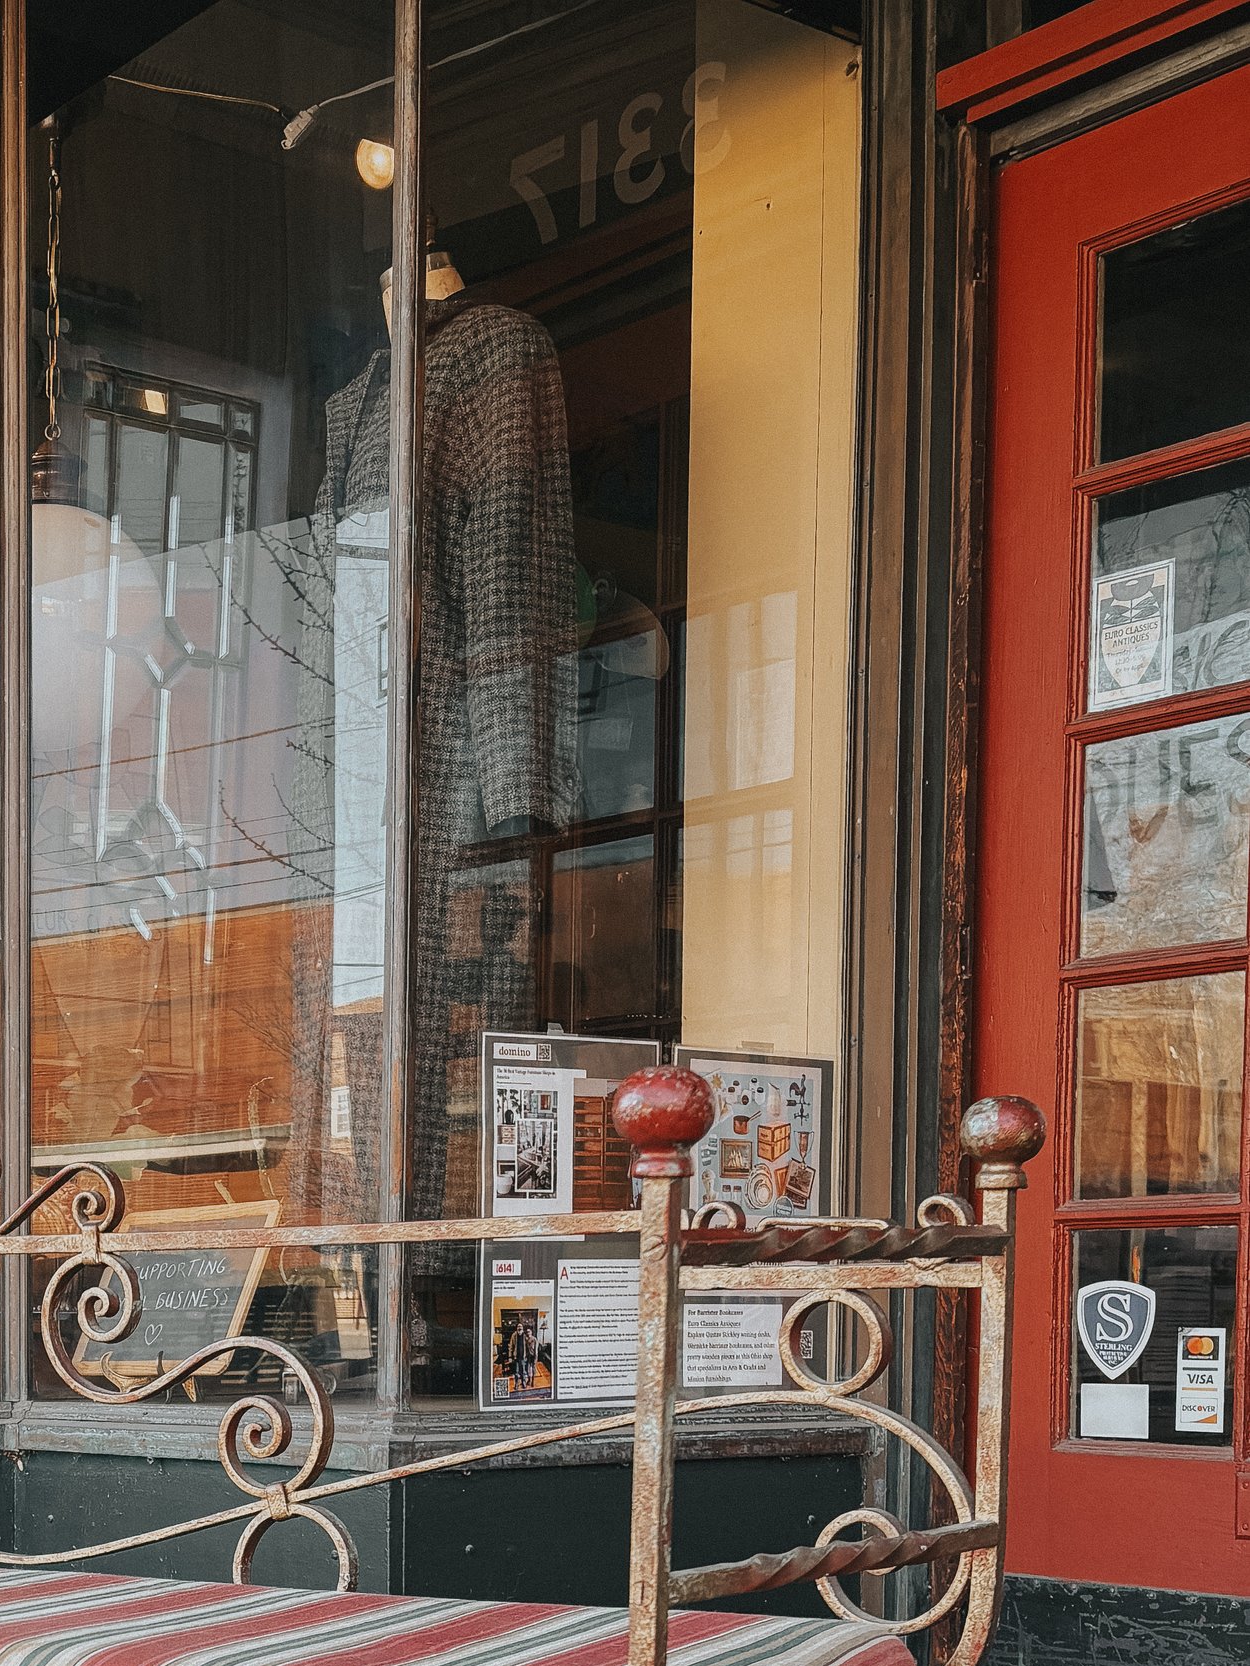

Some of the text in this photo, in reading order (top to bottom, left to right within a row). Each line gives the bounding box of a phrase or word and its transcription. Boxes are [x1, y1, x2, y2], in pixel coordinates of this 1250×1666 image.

[1104, 620, 1159, 641] EURO CLASSICS
[1112, 632, 1150, 648] ANTIQUES
[498, 1045, 531, 1057] domino
[155, 1288, 230, 1311] BUSINESS
[719, 1308, 744, 1316] Bookcases
[1095, 1293, 1134, 1341] S
[1094, 1342, 1133, 1352] STERLING
[1186, 1373, 1214, 1385] VISA
[1181, 1404, 1216, 1413] DISCOVER
